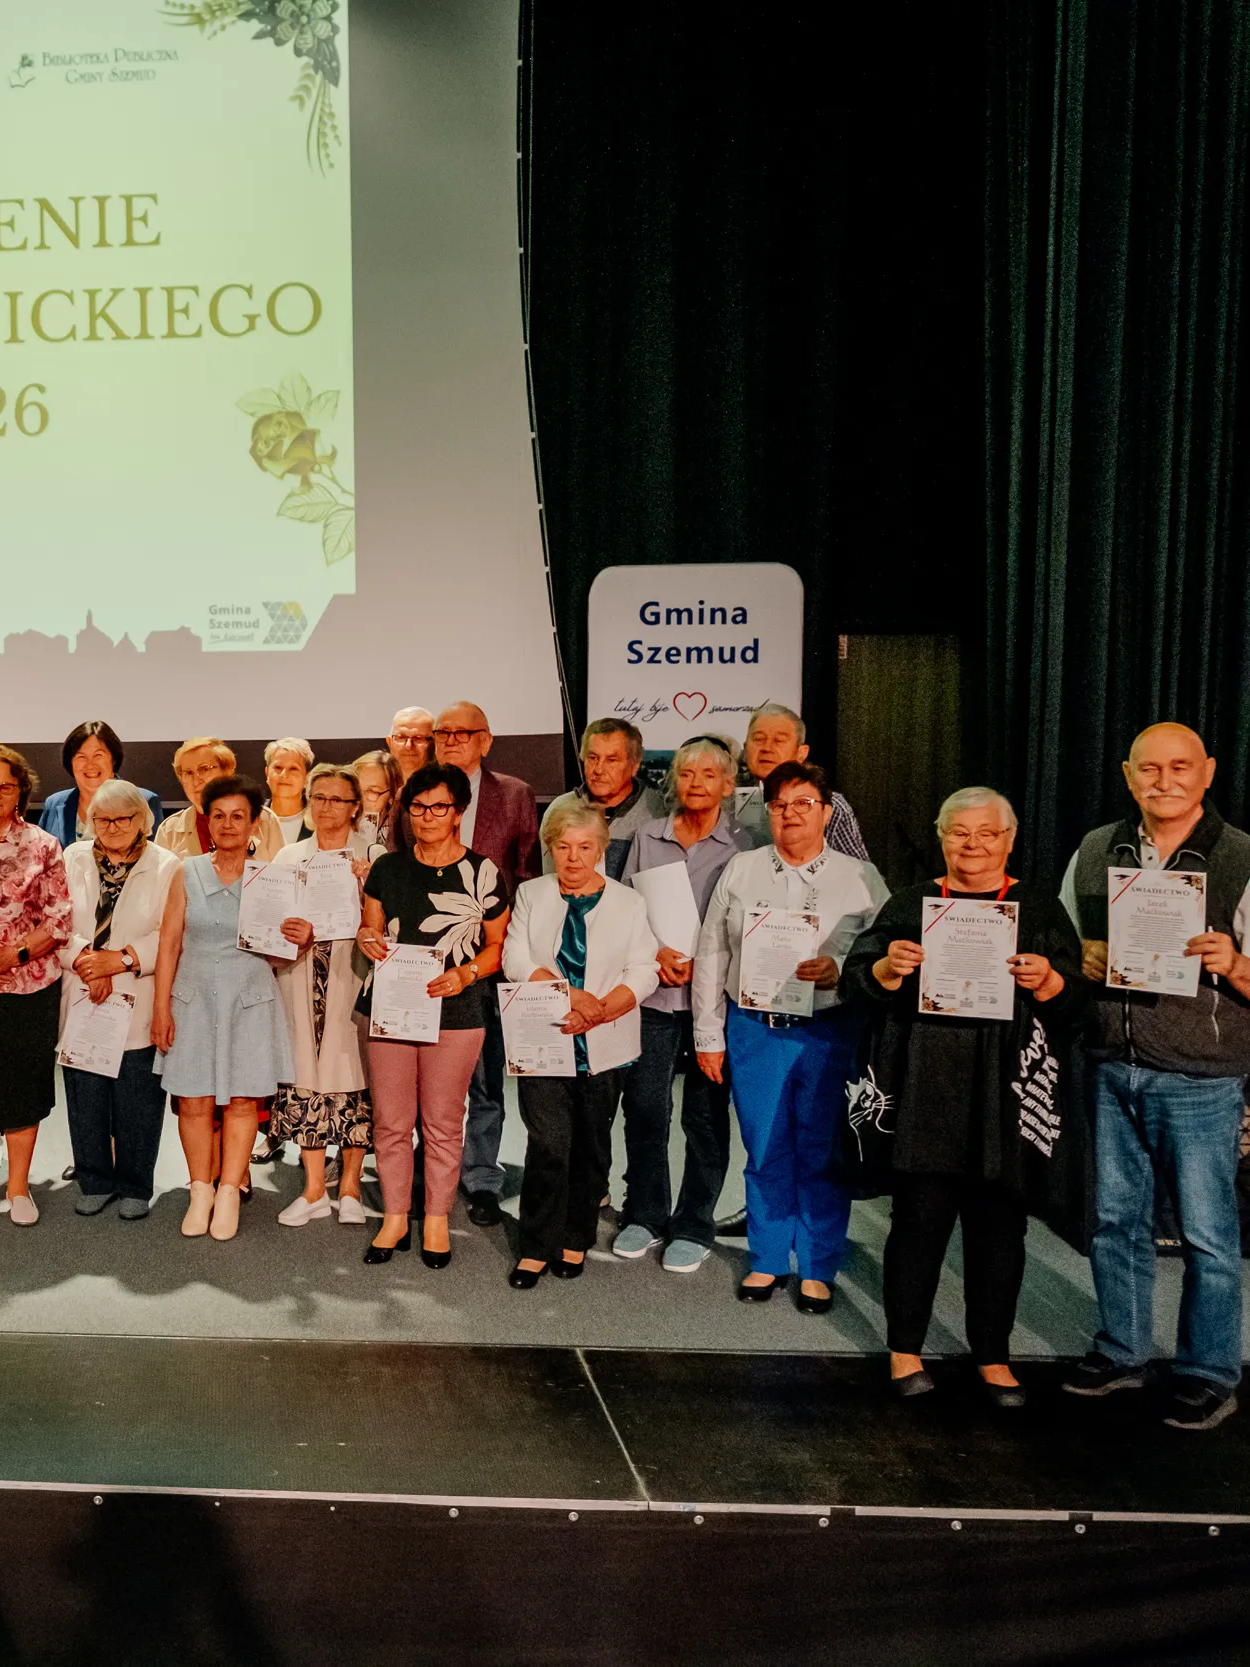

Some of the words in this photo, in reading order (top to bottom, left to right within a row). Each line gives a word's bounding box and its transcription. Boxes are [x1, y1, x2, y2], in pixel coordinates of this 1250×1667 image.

[209, 604, 251, 615] Gmina
[639, 600, 748, 626] Gmina
[209, 618, 260, 629] Szemud
[627, 638, 759, 665] Szemud
